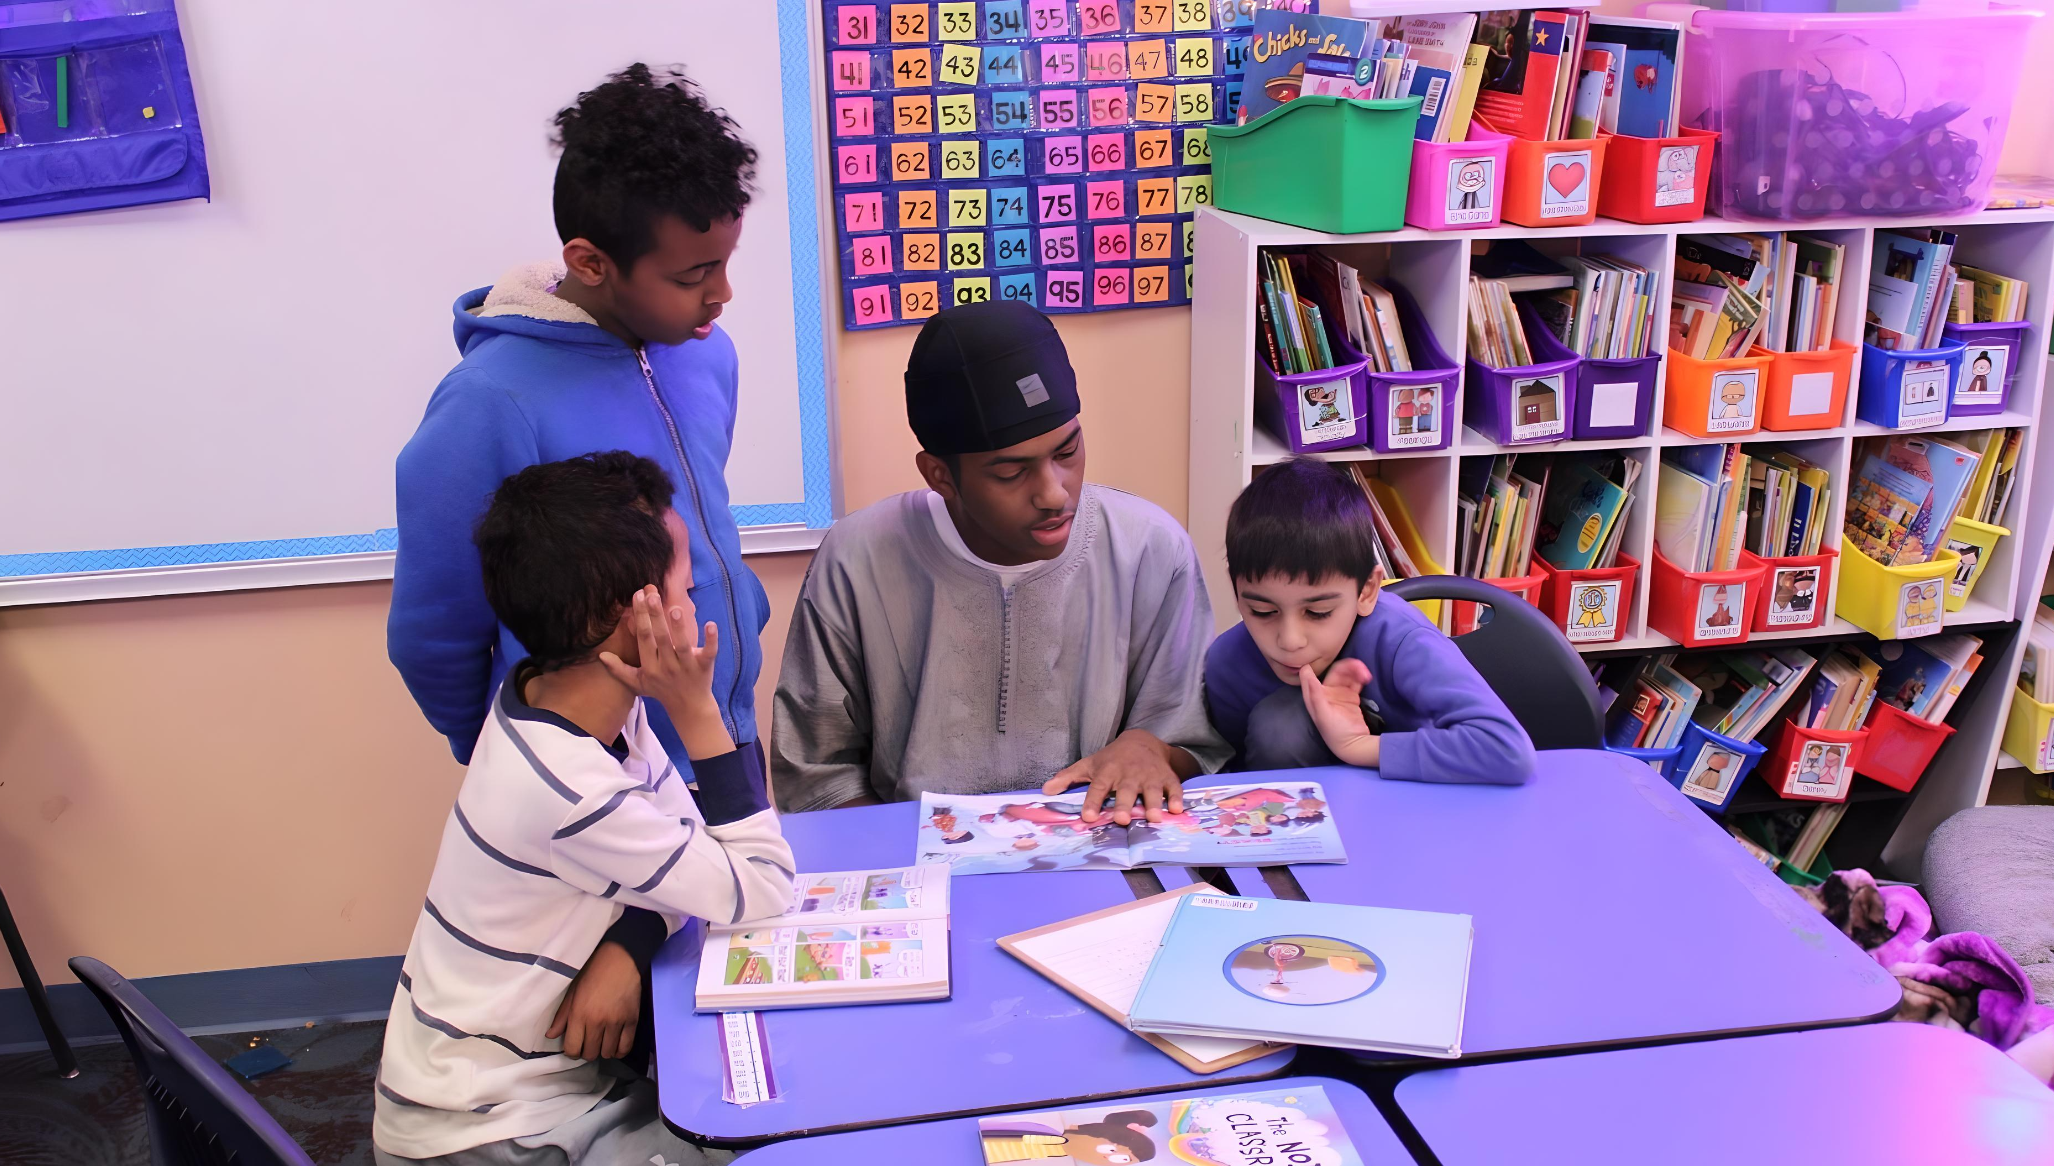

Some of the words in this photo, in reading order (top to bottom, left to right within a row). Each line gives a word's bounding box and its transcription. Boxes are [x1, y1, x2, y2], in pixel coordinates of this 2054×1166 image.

[847, 16, 868, 39] 31
[896, 14, 925, 36] 32
[943, 12, 972, 33] 33
[989, 10, 1021, 35] 34
[1034, 8, 1064, 31] 35
[1085, 4, 1116, 29] 36
[1139, 5, 1168, 25] 37
[1178, 2, 1207, 24] 38
[1253, 24, 1308, 63] Chicks
[840, 62, 863, 86] 41
[897, 58, 927, 79] 42
[945, 55, 975, 78] 43
[988, 54, 1018, 76] 44
[1044, 53, 1075, 74] 45
[1090, 52, 1124, 75] 46
[1134, 50, 1161, 71] 47
[1179, 48, 1209, 68] 48
[1359, 64, 1369, 80] 2
[842, 107, 868, 128] 51
[898, 105, 928, 127] 52
[941, 104, 972, 126] 53
[995, 101, 1028, 125] 54
[1043, 99, 1074, 123] 55
[1091, 97, 1124, 122] 56
[1141, 93, 1169, 114] 57
[1180, 93, 1210, 115] 58
[844, 154, 871, 176] 61
[896, 152, 926, 173] 62
[945, 150, 976, 171] 63
[991, 148, 1022, 170] 64
[1049, 146, 1080, 167] 65
[1091, 143, 1121, 164] 66
[1139, 139, 1168, 161] 67
[852, 202, 877, 223] 71
[904, 200, 932, 221] 72
[953, 199, 982, 220] 73
[996, 196, 1024, 217] 74
[1041, 194, 1072, 218] 75
[1092, 191, 1120, 211] 76
[1142, 188, 1170, 208] 77
[1181, 184, 1208, 205] 78
[861, 245, 886, 267] 81
[907, 243, 936, 263] 82
[950, 242, 982, 266] 83
[999, 238, 1027, 259] 84
[1044, 235, 1076, 260] 85
[1098, 234, 1127, 255] 86
[1140, 233, 1168, 252] 87
[860, 294, 886, 317] 91
[905, 291, 934, 312] 92
[956, 286, 988, 305] 93
[1003, 282, 1033, 302] 94
[1048, 280, 1080, 304] 95
[1097, 275, 1126, 295] 96
[1137, 276, 1164, 296] 97
[1266, 1116, 1295, 1136] The
